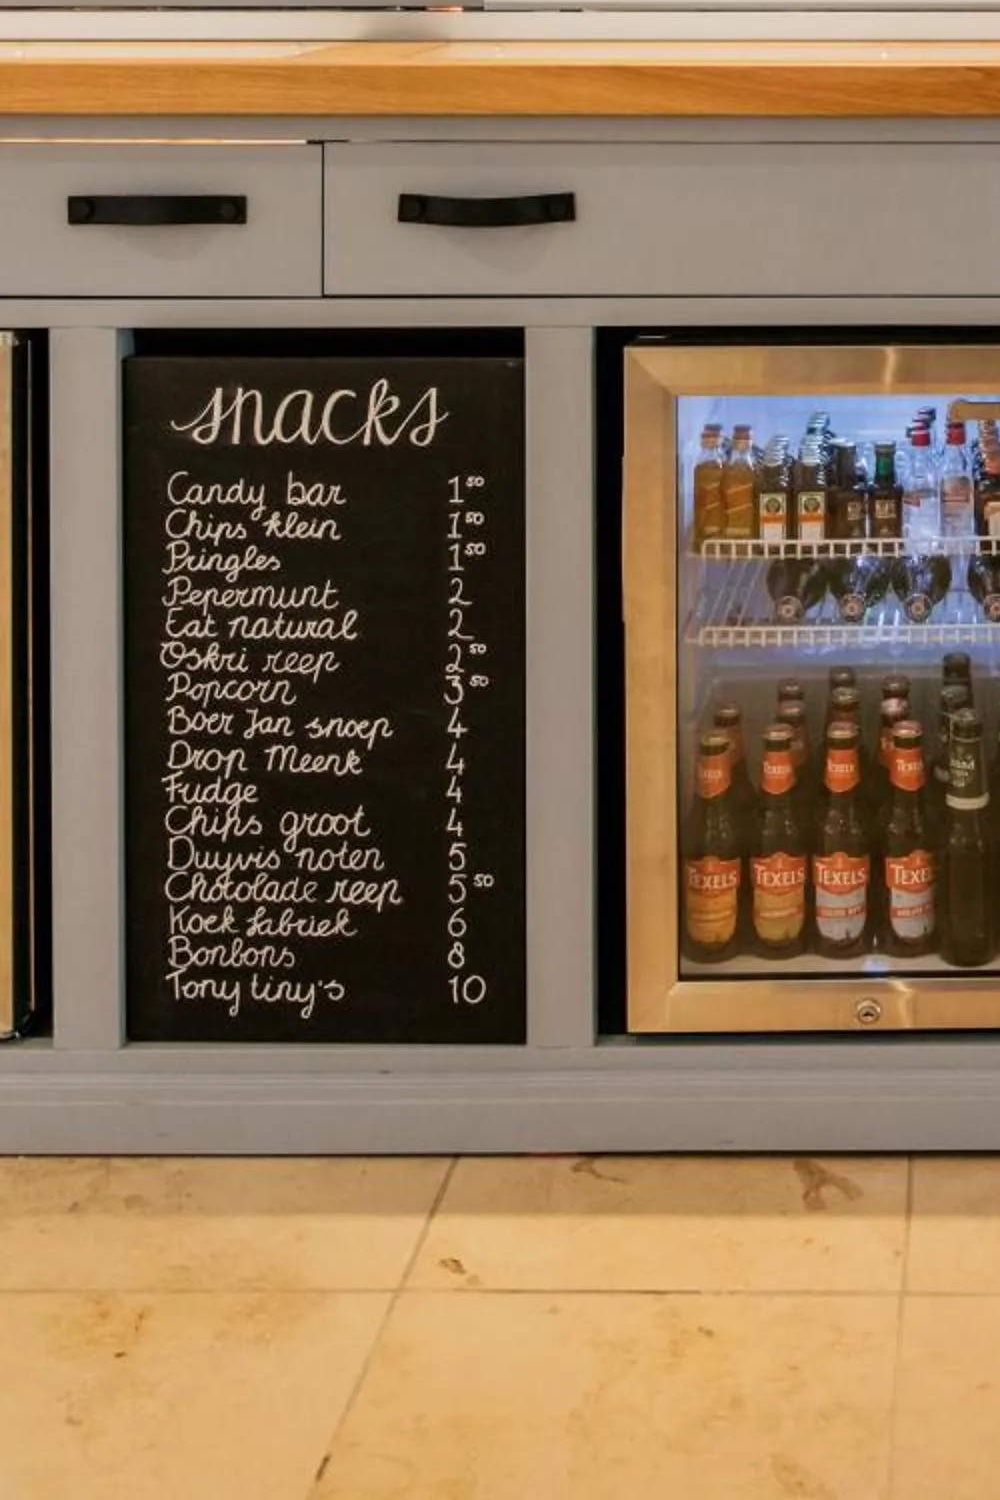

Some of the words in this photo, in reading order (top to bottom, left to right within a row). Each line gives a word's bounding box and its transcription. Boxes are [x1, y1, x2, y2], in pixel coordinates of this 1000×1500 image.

[170, 378, 449, 446] snacks
[167, 472, 266, 520] Candy
[287, 472, 347, 506] bar
[165, 509, 247, 546] Chips
[264, 512, 341, 540] klein
[162, 540, 280, 582] Pringles
[162, 575, 339, 616] Pepermunt
[448, 577, 472, 605] 2
[165, 608, 218, 638] Eat
[228, 610, 358, 639] natural
[448, 609, 474, 638] 2
[160, 642, 249, 673] Oskri
[263, 649, 340, 684] reep
[165, 671, 297, 707] Popcorn
[167, 707, 234, 735] Boer
[243, 709, 293, 739] Jan
[305, 714, 393, 749] snoep
[447, 708, 467, 738] 4
[167, 741, 248, 779] Drop
[265, 745, 363, 775] Meenk
[445, 744, 464, 775] 4
[162, 771, 259, 816] Fudge
[447, 776, 462, 803] 4
[165, 805, 262, 842] Chips
[279, 805, 371, 853] groot
[446, 808, 463, 836] 4
[168, 836, 280, 885] Duyvis
[296, 842, 385, 870] noten
[448, 843, 468, 871] 5
[687, 866, 737, 889] TEXELS
[754, 864, 804, 888] TEXELS
[816, 863, 867, 886] TEXELS
[326, 879, 403, 912] reep
[169, 906, 238, 935] Koek
[448, 908, 466, 937] 6
[168, 937, 295, 968] Bonbons
[448, 943, 464, 968] 8
[166, 969, 240, 1016] Tony
[251, 976, 345, 1019] tiny's
[448, 975, 486, 1004] 10
